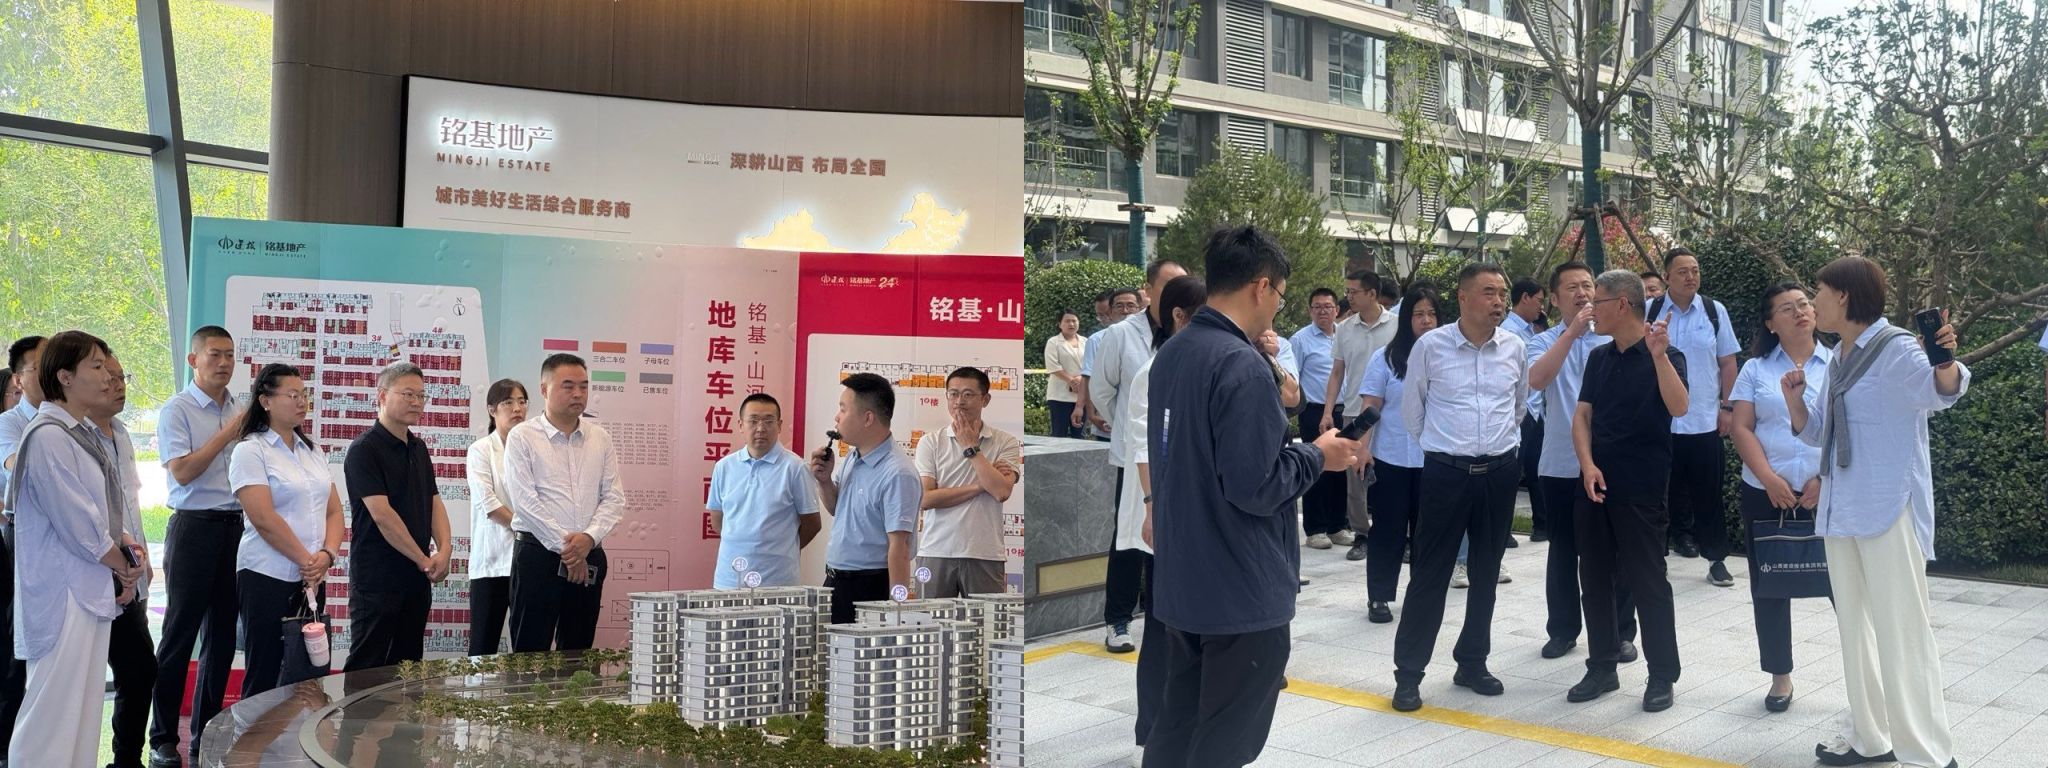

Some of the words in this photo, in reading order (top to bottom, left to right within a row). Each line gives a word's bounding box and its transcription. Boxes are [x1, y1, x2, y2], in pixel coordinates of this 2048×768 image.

[440, 117, 553, 152] 铭基地产
[436, 152, 489, 167] MINGJI
[498, 158, 551, 172] ESTATE
[730, 152, 804, 173] 深耕山西
[811, 156, 887, 177] 布局全国
[435, 185, 632, 219] 城市美好生活综合服务商
[264, 241, 307, 253] 铭基地产
[929, 296, 1022, 324] 铭基·山
[592, 355, 626, 364] 三合二车位
[644, 357, 670, 366] 子母车位
[591, 384, 625, 393] 新能源车位
[702, 300, 737, 540] 地库车位平
